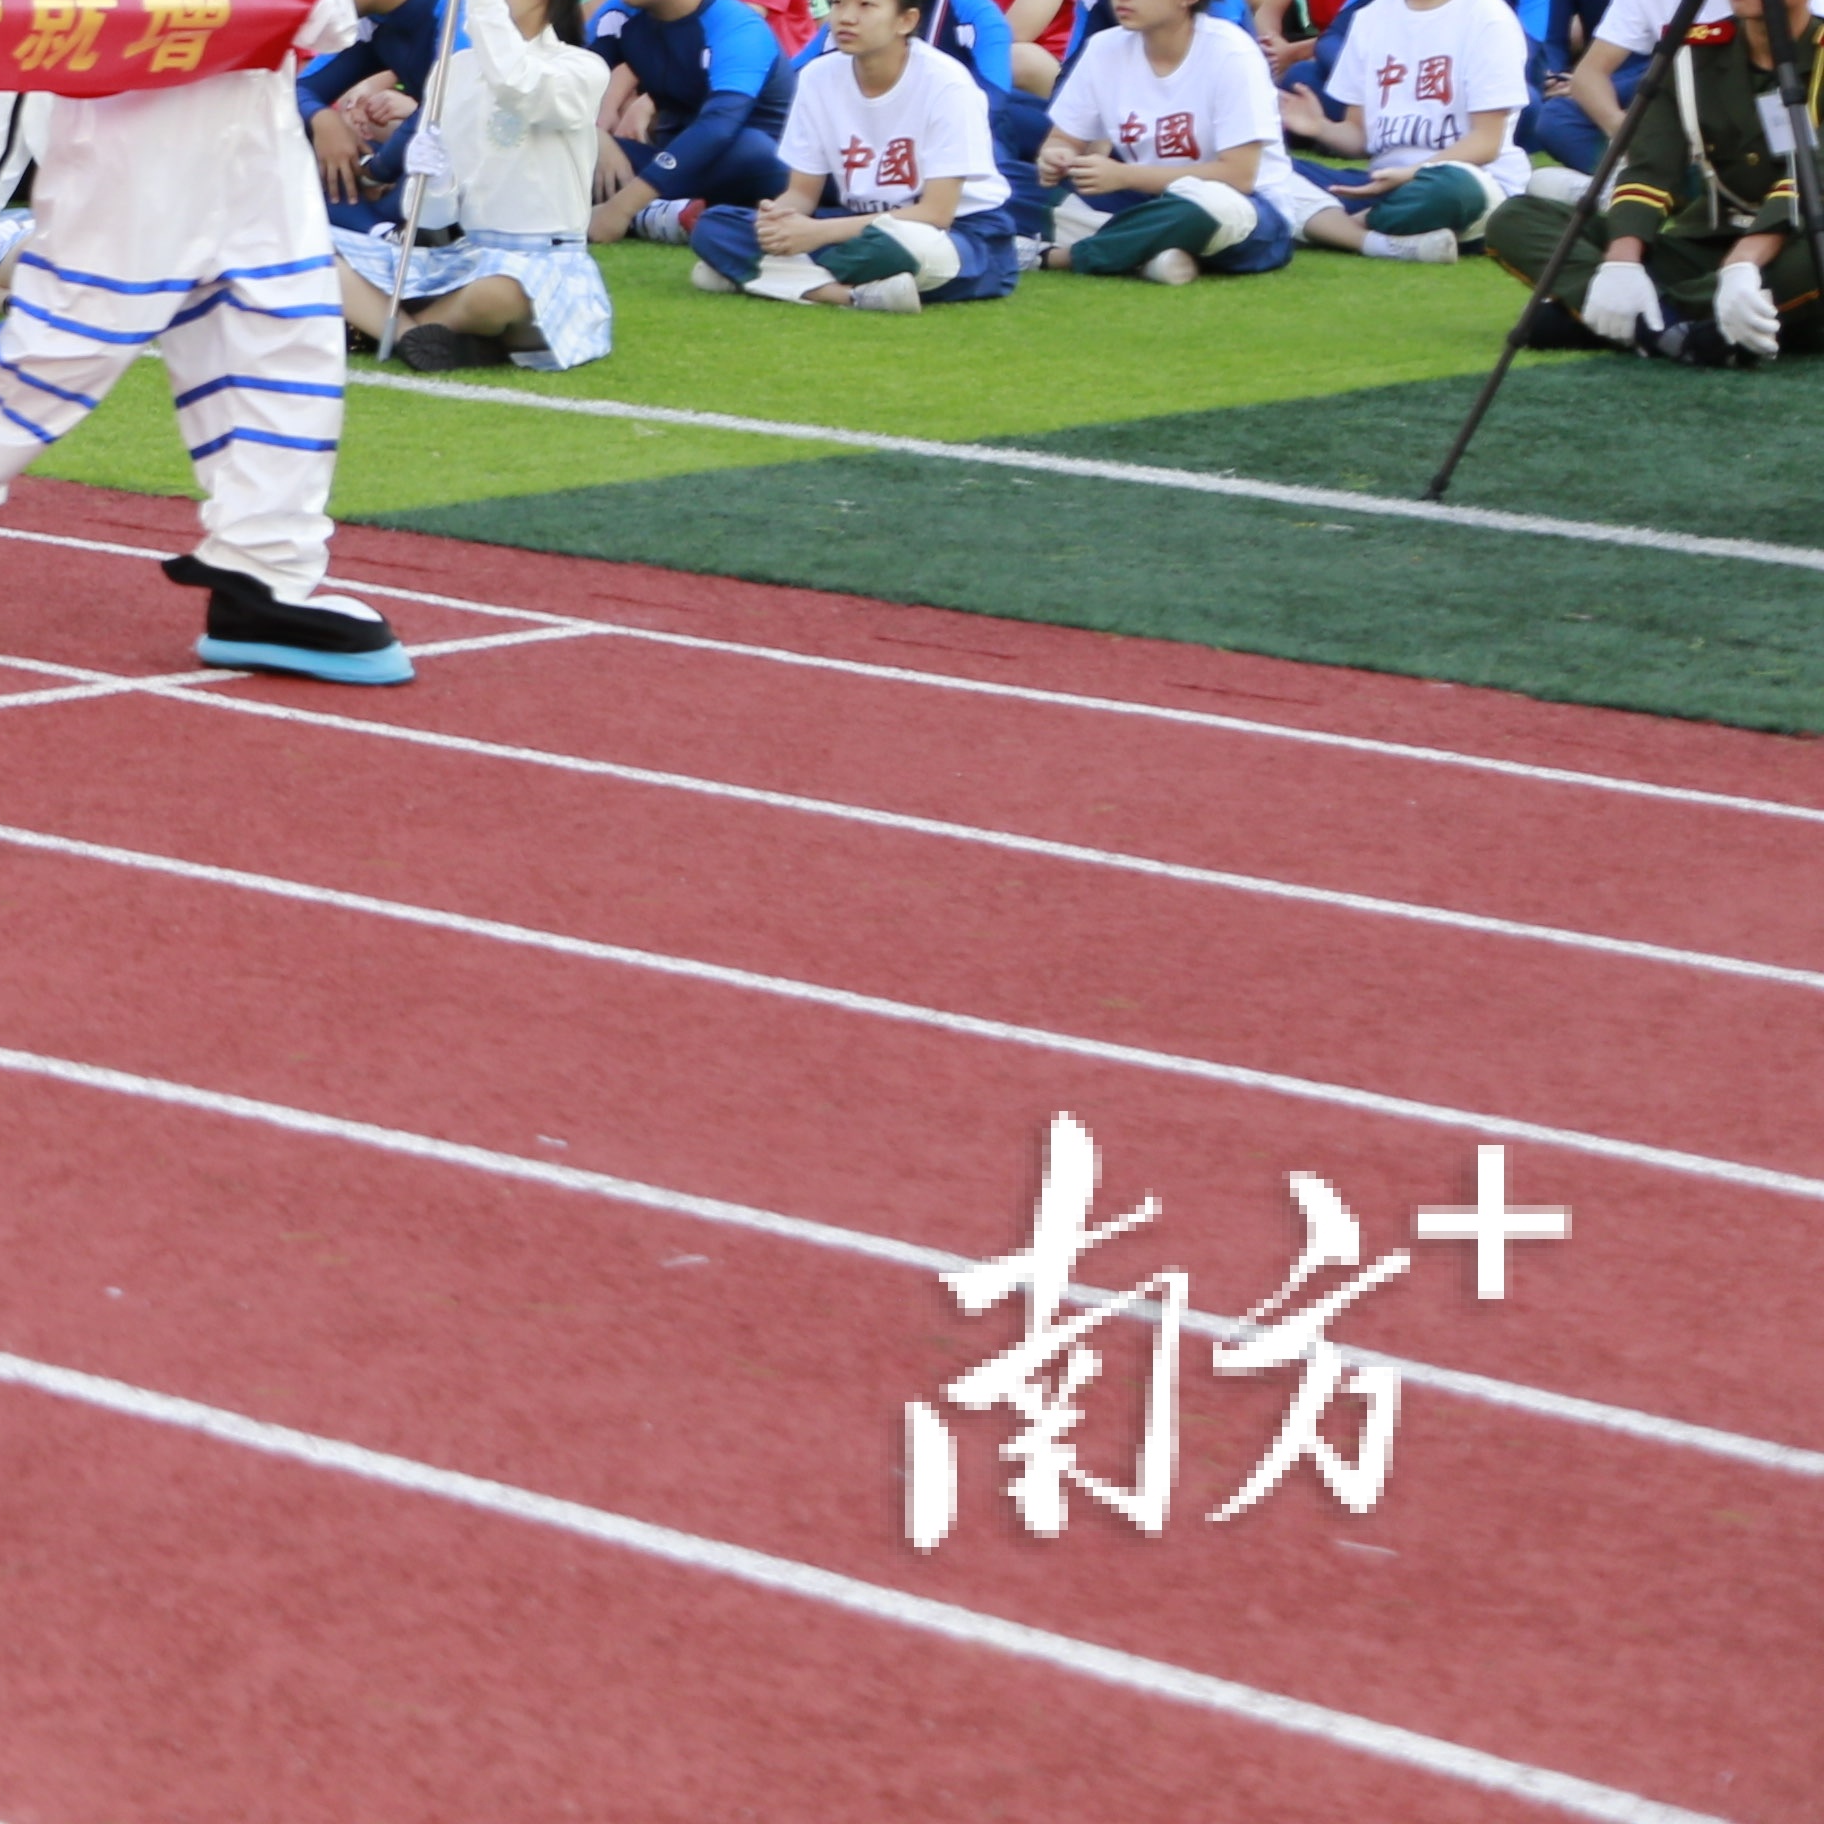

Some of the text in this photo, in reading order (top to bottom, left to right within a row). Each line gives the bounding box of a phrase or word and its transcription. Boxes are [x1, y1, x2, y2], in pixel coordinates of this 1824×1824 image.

[1376, 54, 1453, 109] 中國
[840, 134, 919, 191] 中國
[1119, 111, 1201, 161] 中國
